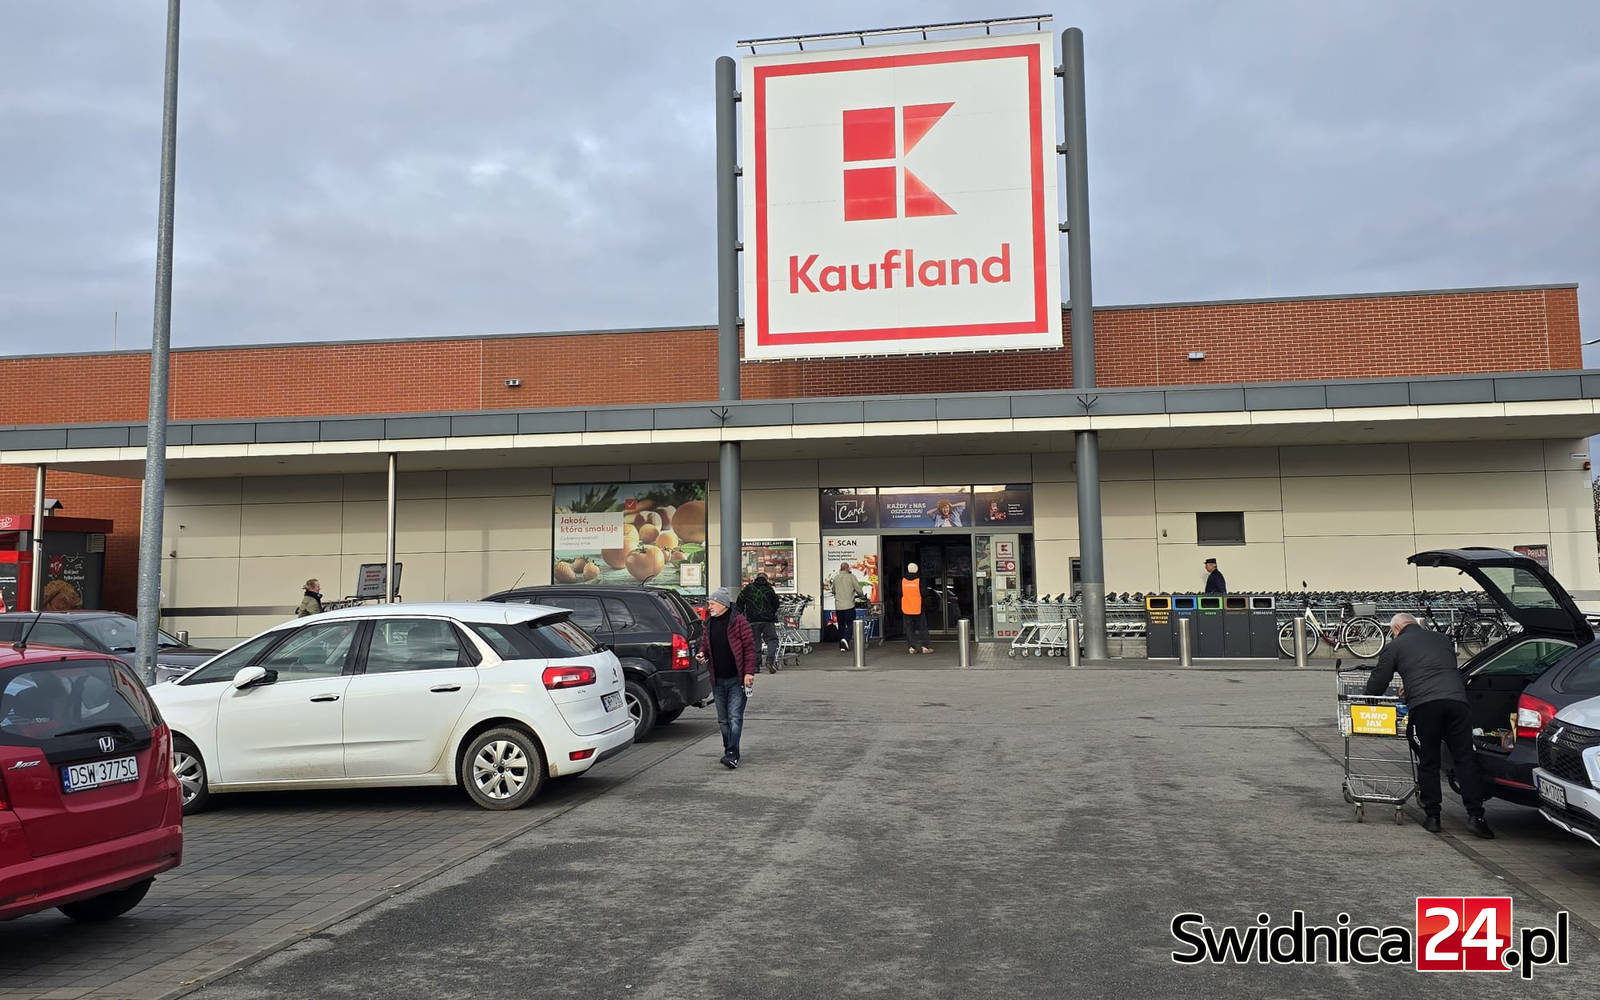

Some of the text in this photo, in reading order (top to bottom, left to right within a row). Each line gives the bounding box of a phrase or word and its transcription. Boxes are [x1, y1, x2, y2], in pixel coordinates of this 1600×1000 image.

[789, 242, 1011, 294] Kaufland
[838, 500, 866, 521] Card
[560, 516, 589, 525] Jakość,
[560, 524, 619, 533] która smakuje
[837, 539, 858, 547] SCAN
[1360, 711, 1388, 720] TANIO
[70, 758, 136, 786] DSW 3775C
